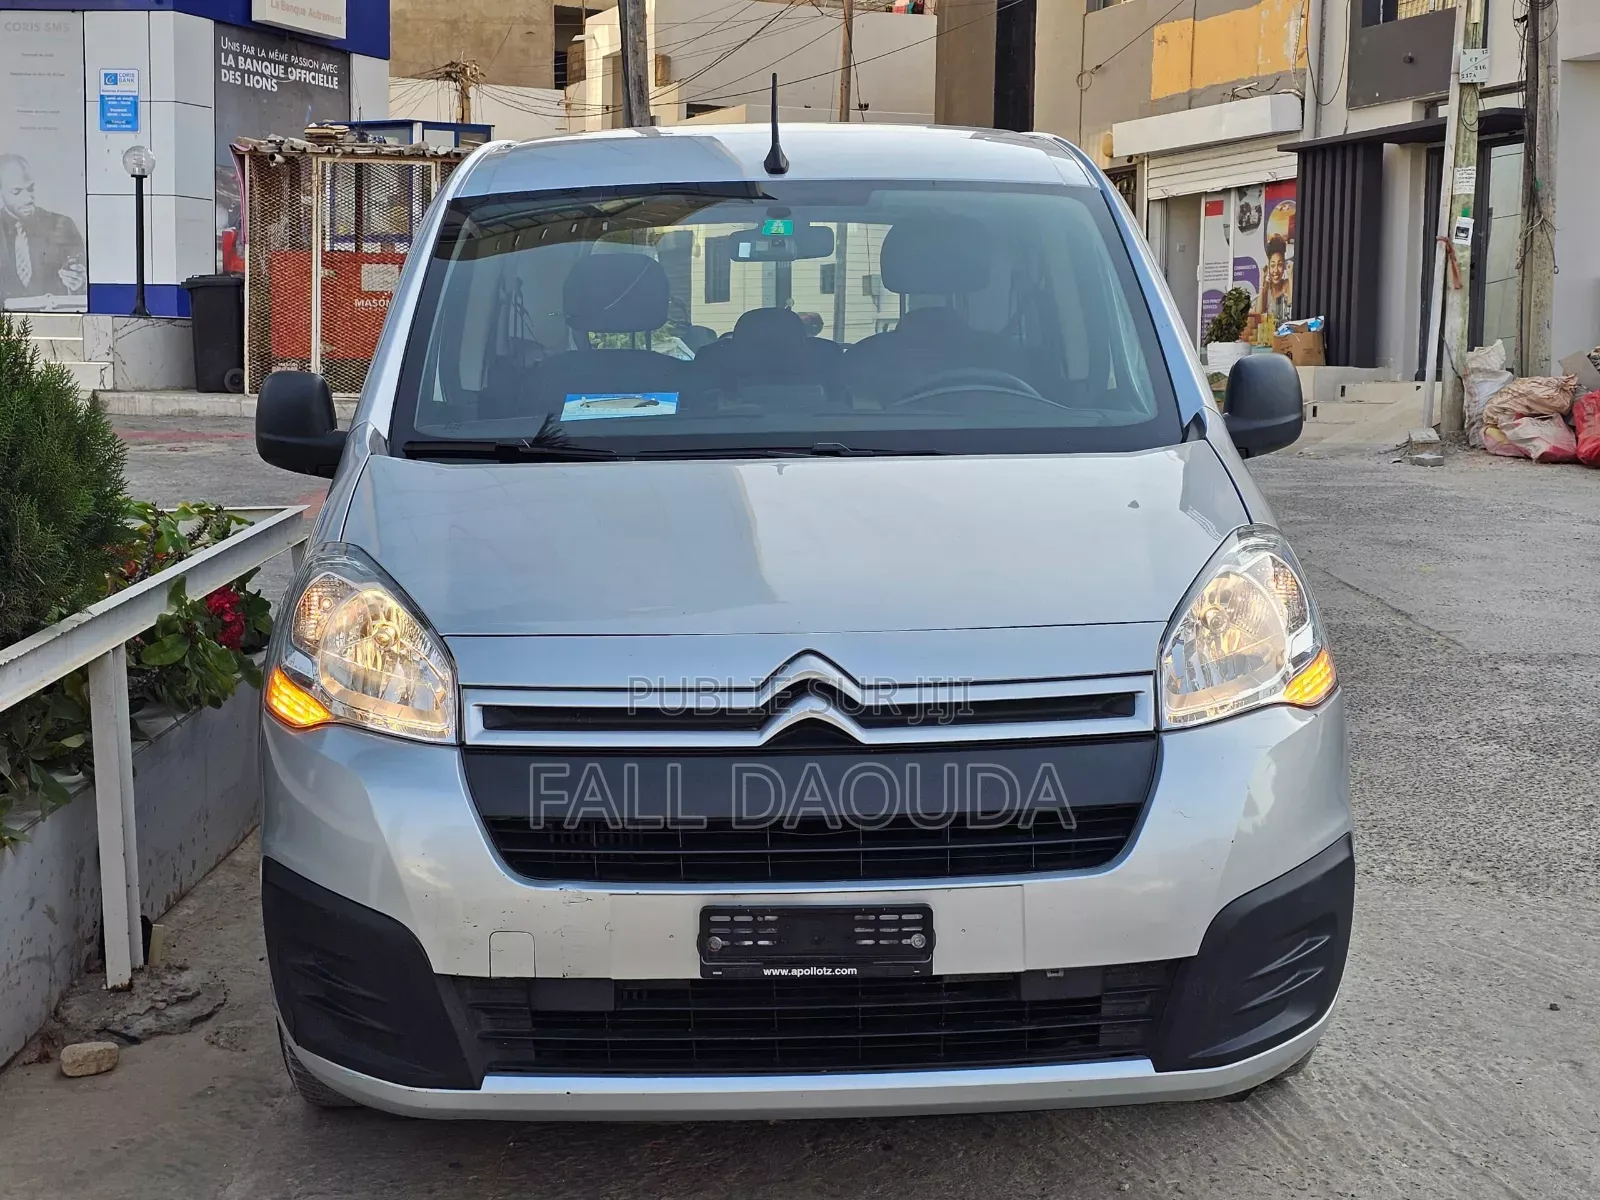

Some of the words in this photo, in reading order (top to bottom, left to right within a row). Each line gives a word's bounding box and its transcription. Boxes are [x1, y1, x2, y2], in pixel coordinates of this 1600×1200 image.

[281, 0, 306, 16] Banque
[308, 8, 342, 24] Autrement
[4, 22, 41, 32] CORIS
[221, 52, 235, 67] LA
[238, 56, 285, 77] BANQUE
[288, 67, 339, 89] OFFICIELLE
[243, 44, 255, 55] PAR
[258, 48, 266, 58] LA
[269, 49, 289, 62] MÊME
[291, 55, 319, 69] PASSION
[321, 63, 338, 74] AVEC
[221, 69, 241, 85] DES
[245, 73, 278, 92] LIONS
[763, 966, 858, 977] www.apollotz.com
